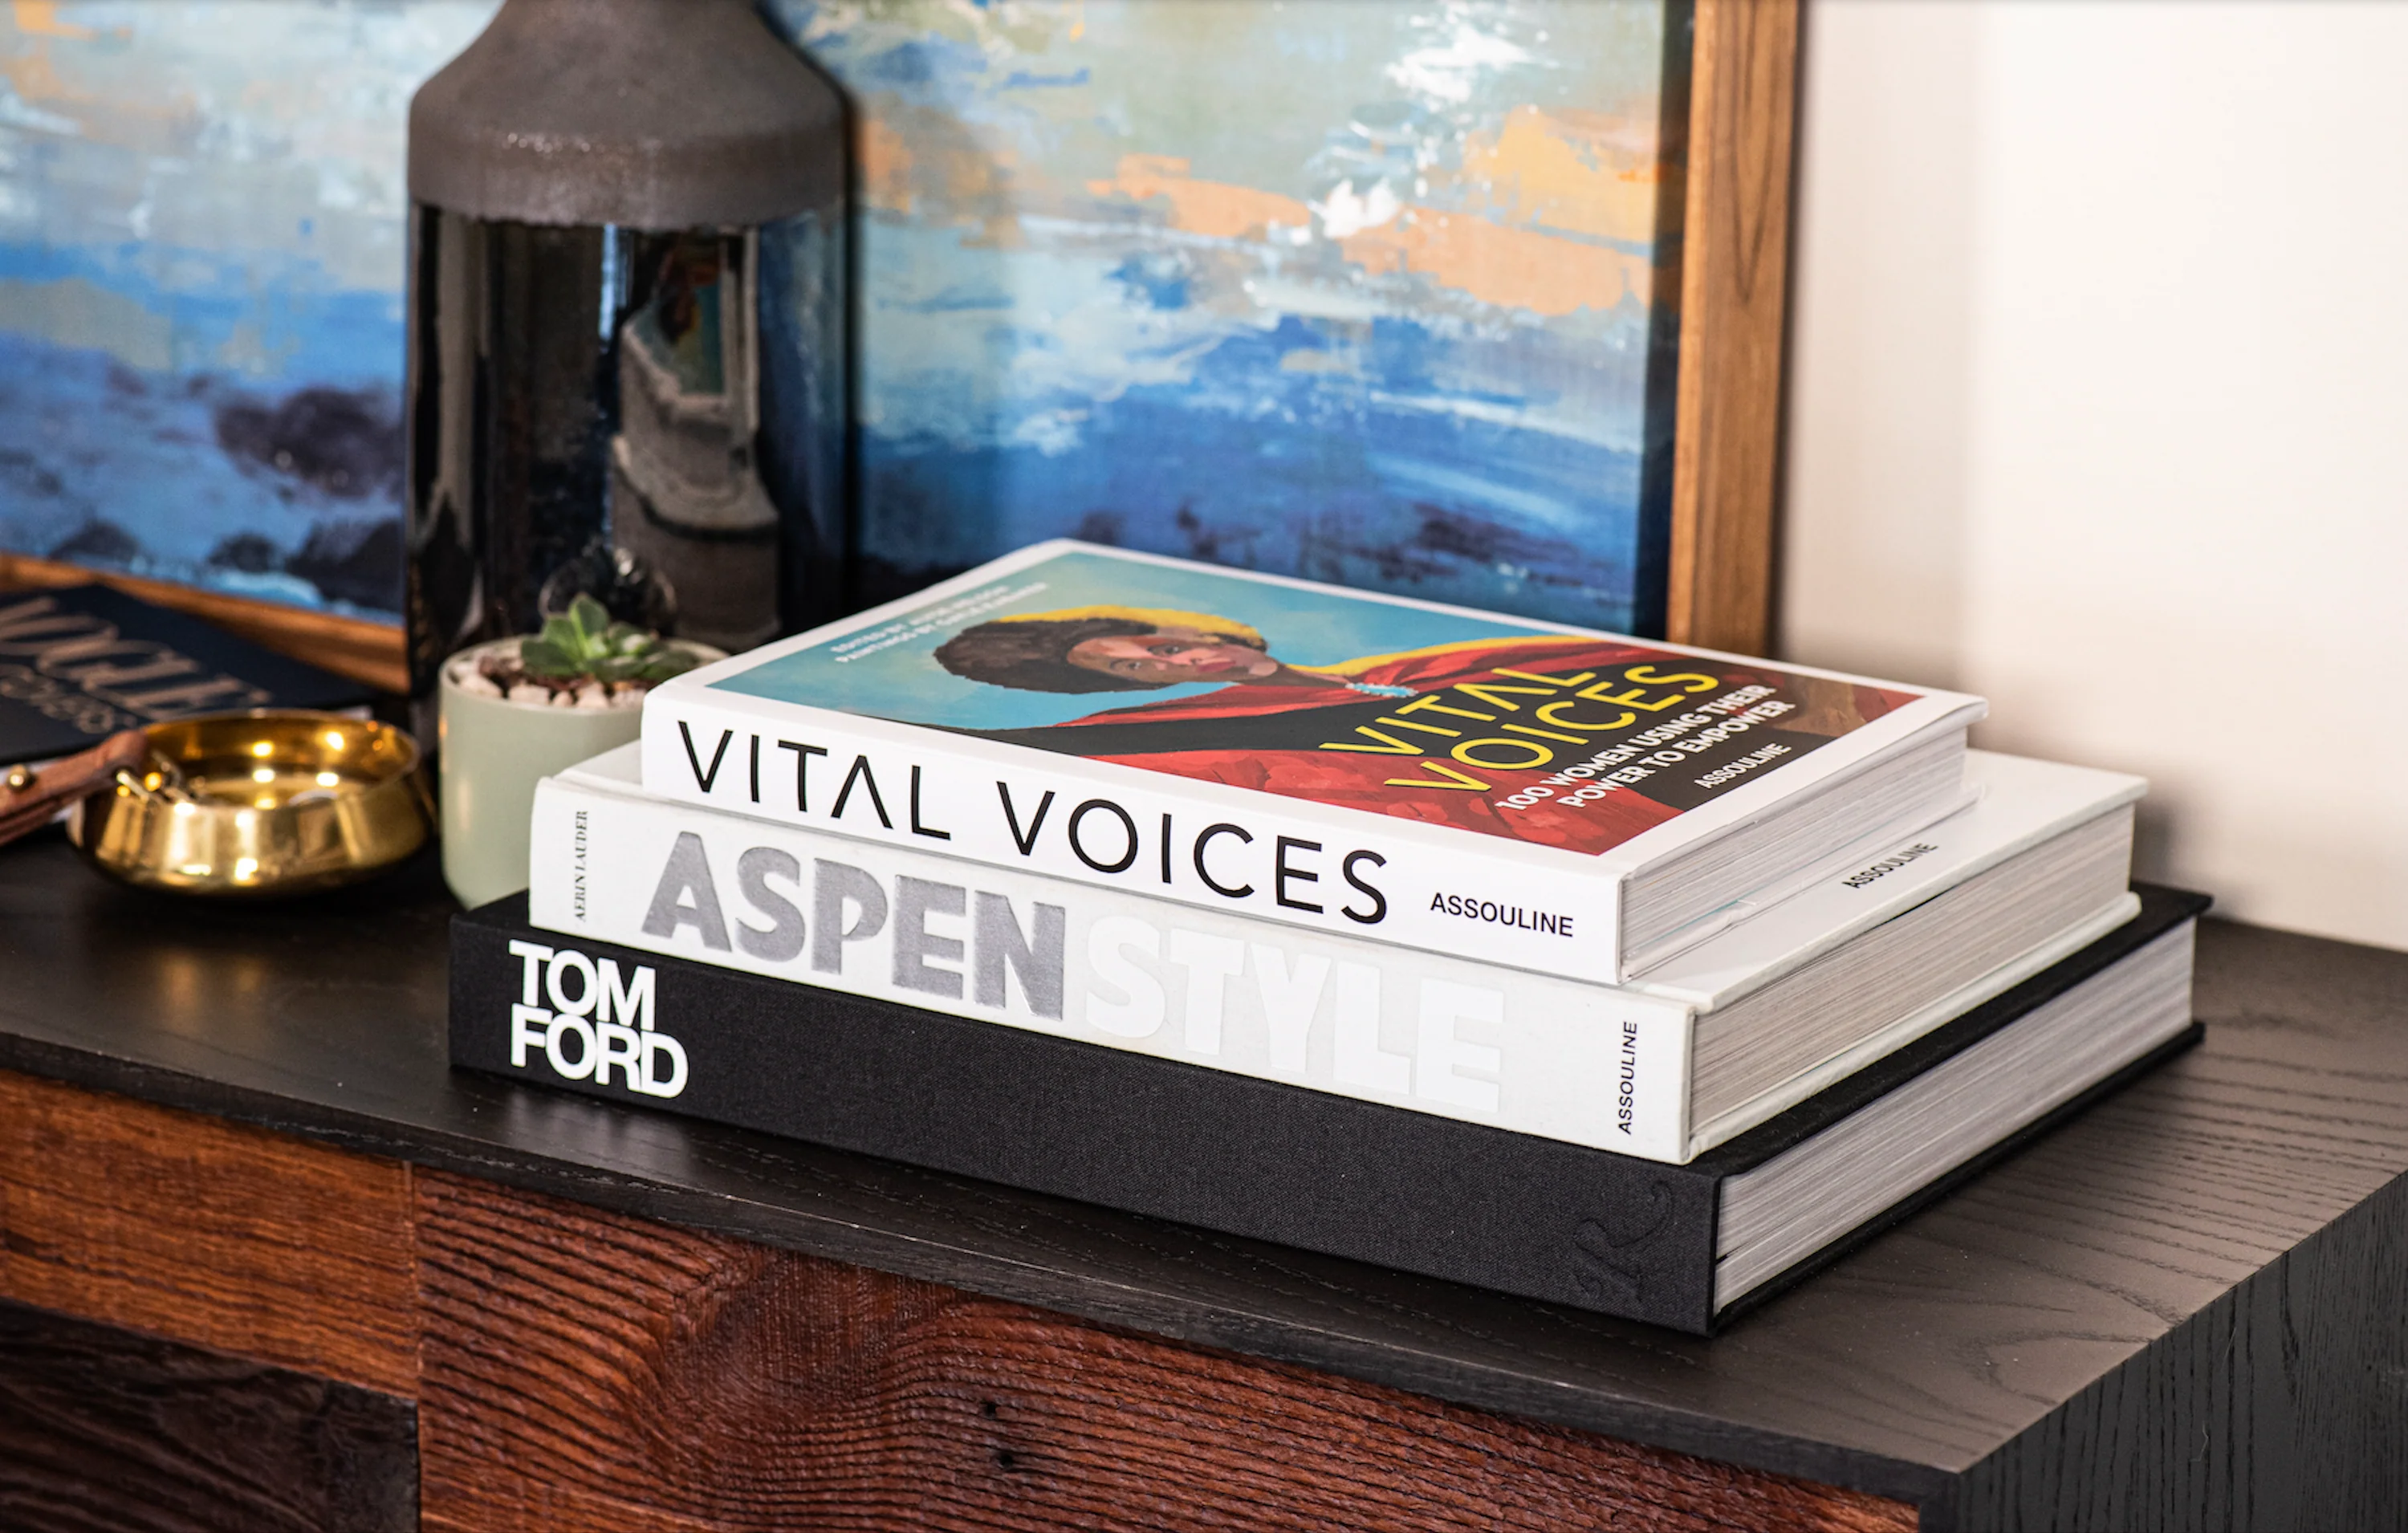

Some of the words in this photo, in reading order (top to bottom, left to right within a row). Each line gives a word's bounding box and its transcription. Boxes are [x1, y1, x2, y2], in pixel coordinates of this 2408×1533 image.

[1319, 667, 1597, 755] VITAL
[1384, 665, 1719, 792] VOICES
[1495, 785, 1555, 811] 100
[1540, 743, 1645, 787] WOMEN
[1628, 711, 1713, 748] USING
[1695, 683, 1777, 716] THEIR
[1556, 765, 1656, 808] POWER
[1637, 750, 1686, 769] TO
[1672, 699, 1796, 754] EMPOWER
[1694, 742, 1792, 790] ASSOULINE
[575, 811, 588, 872] LAUDER
[677, 720, 951, 841] VITAL
[996, 781, 1388, 925] VOICES
[1430, 893, 1575, 938] ASSOULINE
[1841, 843, 1939, 889] ASSOULINE
[574, 874, 587, 923] AERIN
[508, 940, 657, 1033] TOM
[641, 832, 1067, 1023] ASPEN
[1084, 915, 1505, 1114] STYLE
[510, 1003, 689, 1099] FORD
[1617, 1021, 1638, 1136] ASSOULINE
